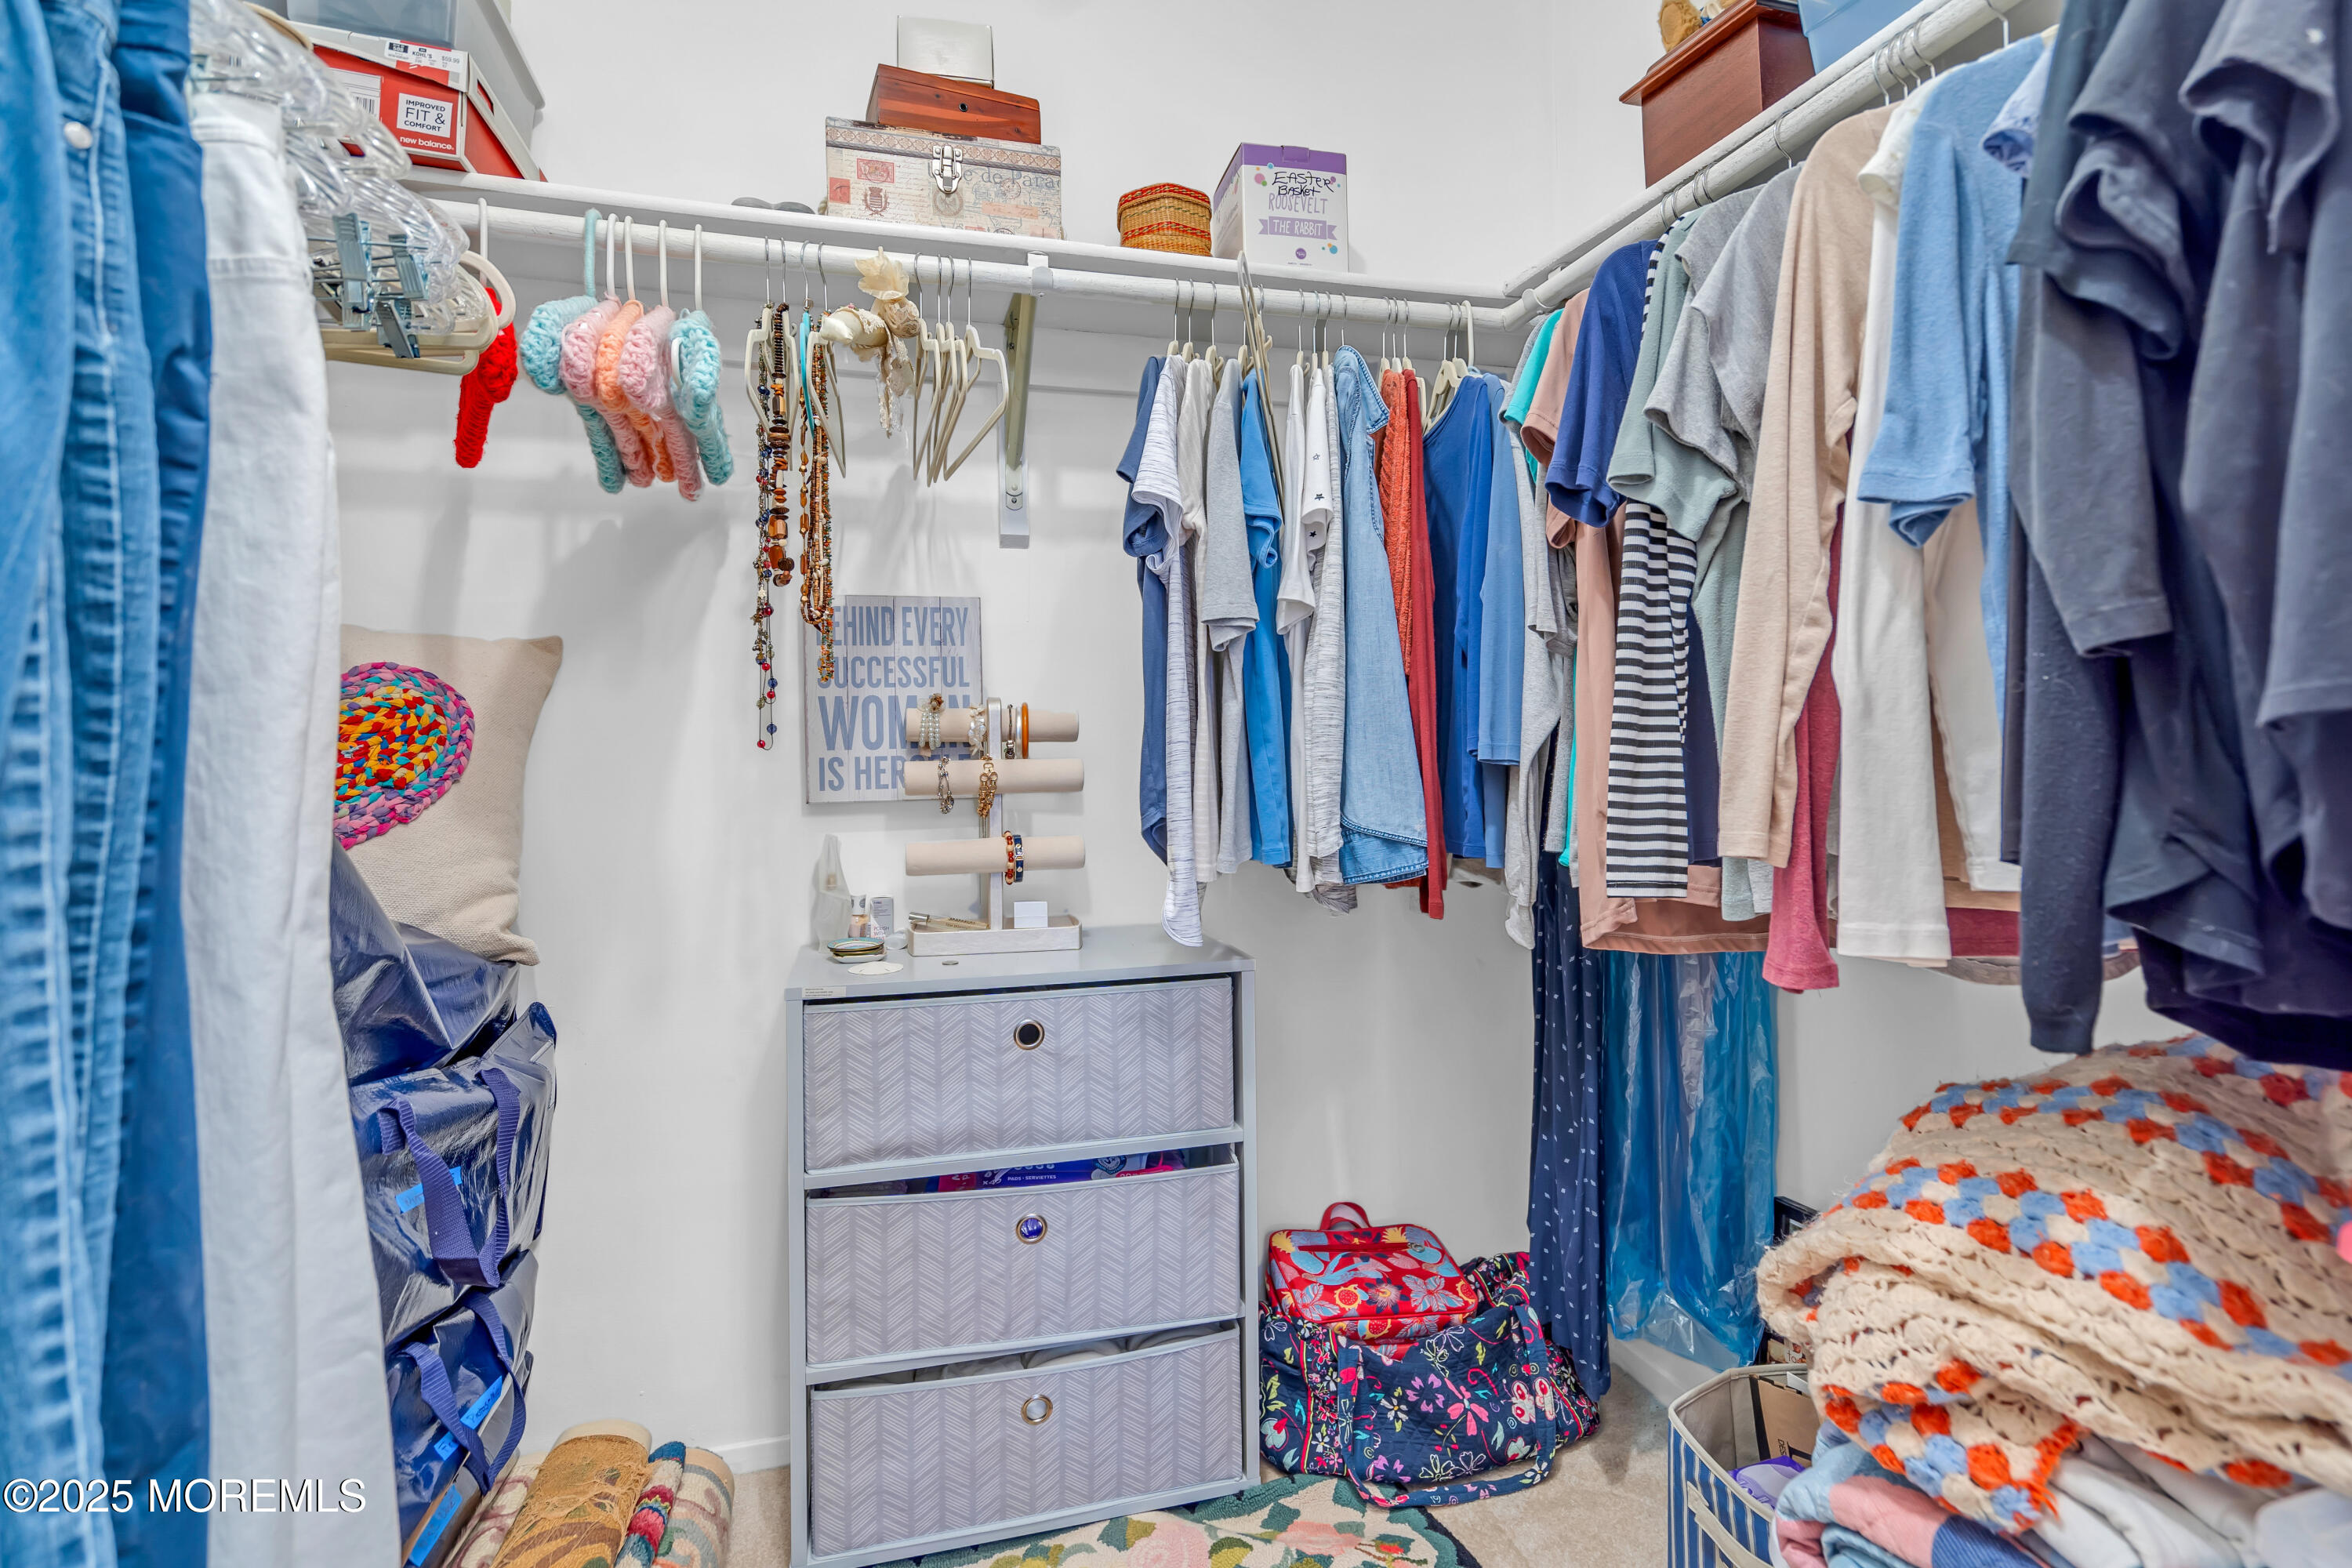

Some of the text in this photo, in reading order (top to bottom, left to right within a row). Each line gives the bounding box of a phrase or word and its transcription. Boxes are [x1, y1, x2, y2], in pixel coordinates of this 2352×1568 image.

[405, 99, 446, 112] IMPROVED
[405, 107, 445, 125] FIT &
[404, 120, 442, 132] COMFORT
[400, 136, 452, 150] new balance
[1269, 192, 1328, 214] ROOSEVELT
[1272, 220, 1323, 236] THE RABBIT
[816, 605, 969, 647] EHIND EVERY
[818, 756, 844, 792] IS
